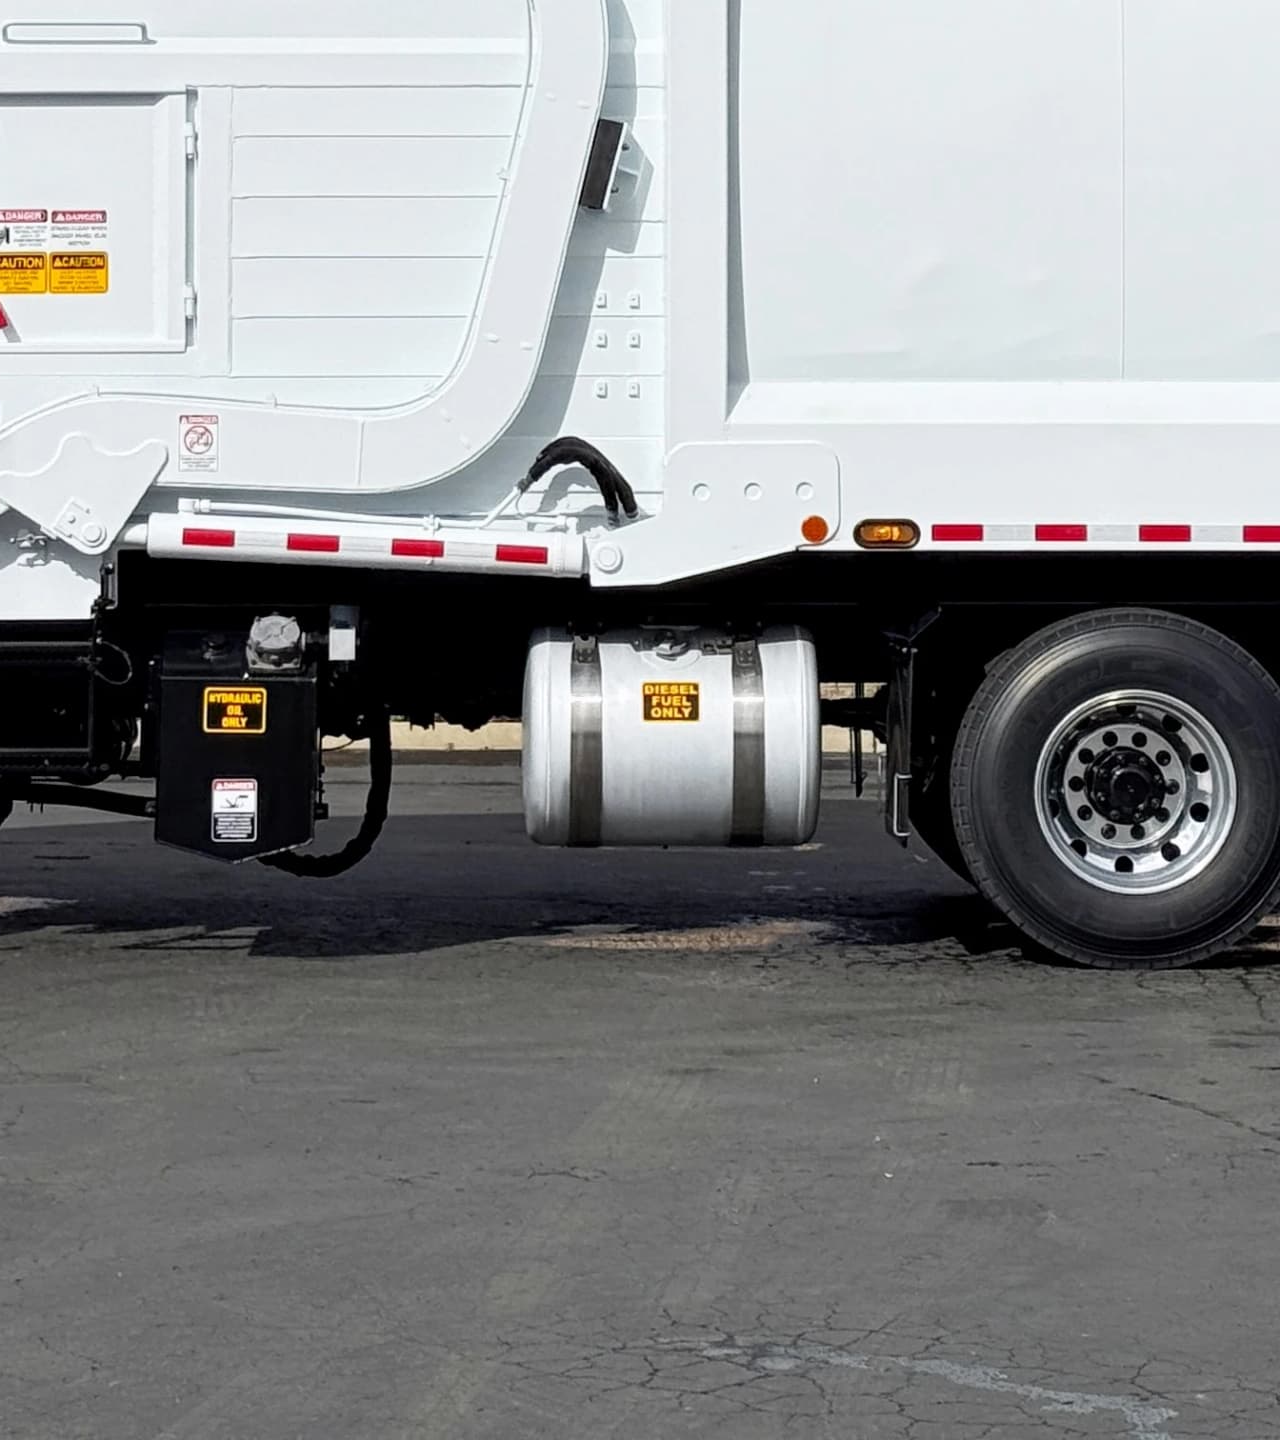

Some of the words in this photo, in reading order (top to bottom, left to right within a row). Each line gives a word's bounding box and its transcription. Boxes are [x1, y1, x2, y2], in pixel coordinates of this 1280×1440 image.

[5, 211, 42, 221] DANGER
[65, 213, 103, 222] DANGER
[62, 257, 104, 267] CAUTION
[644, 684, 698, 695] DIESEL
[208, 692, 262, 704] HYDRAULIC
[651, 695, 692, 707] FUEL
[650, 707, 693, 718] ONLY
[221, 716, 248, 728] ONLY
